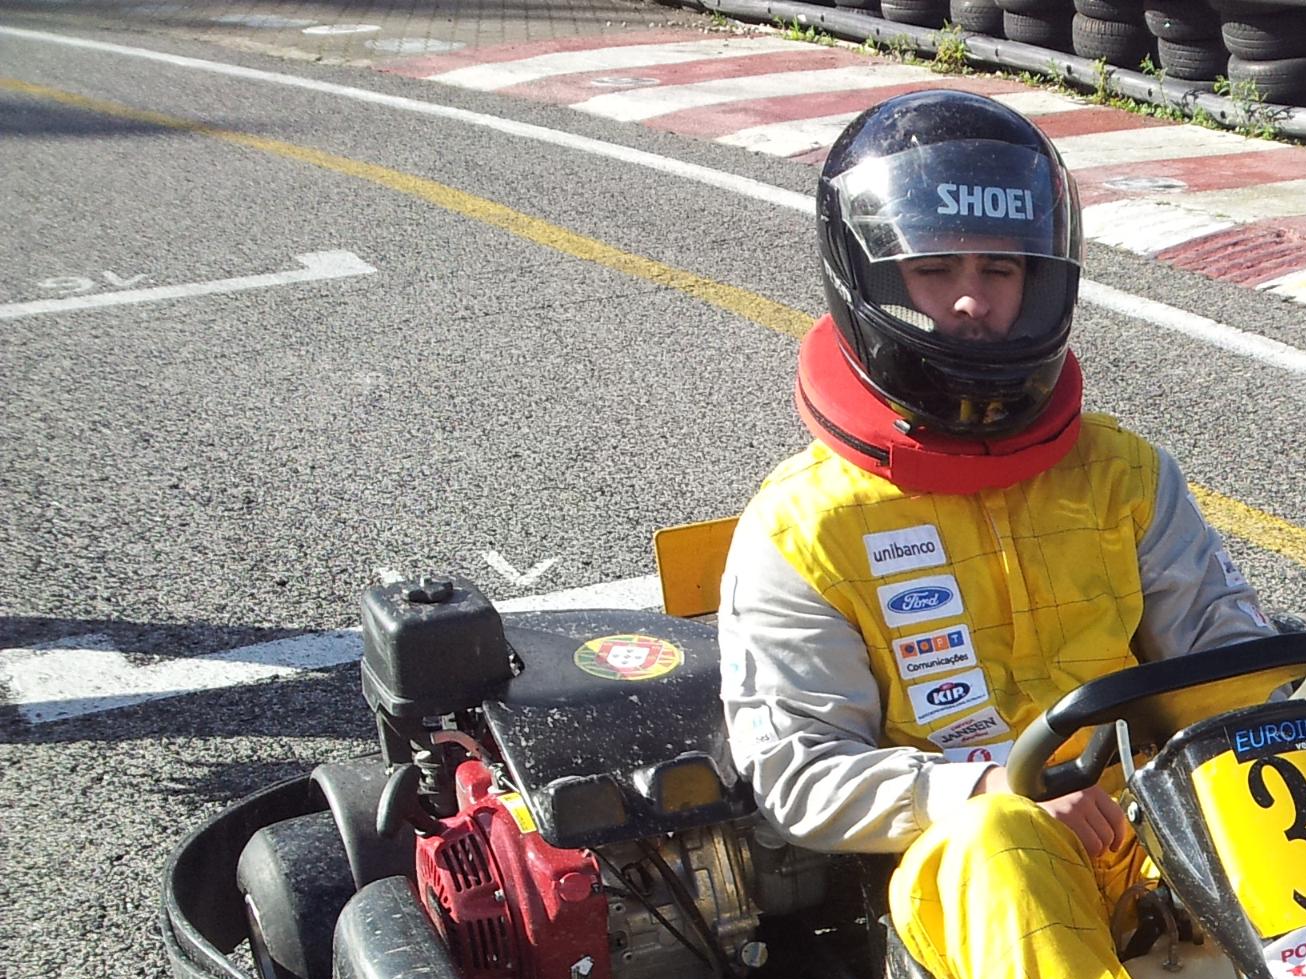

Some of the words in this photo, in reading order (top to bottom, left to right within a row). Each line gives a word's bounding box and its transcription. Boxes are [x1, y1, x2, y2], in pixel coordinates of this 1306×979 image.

[937, 183, 1034, 220] SHOEI
[873, 541, 936, 562] unibanco
[901, 591, 939, 610] Ford
[906, 653, 969, 672] Comunicações
[941, 716, 998, 743] JANSEN
